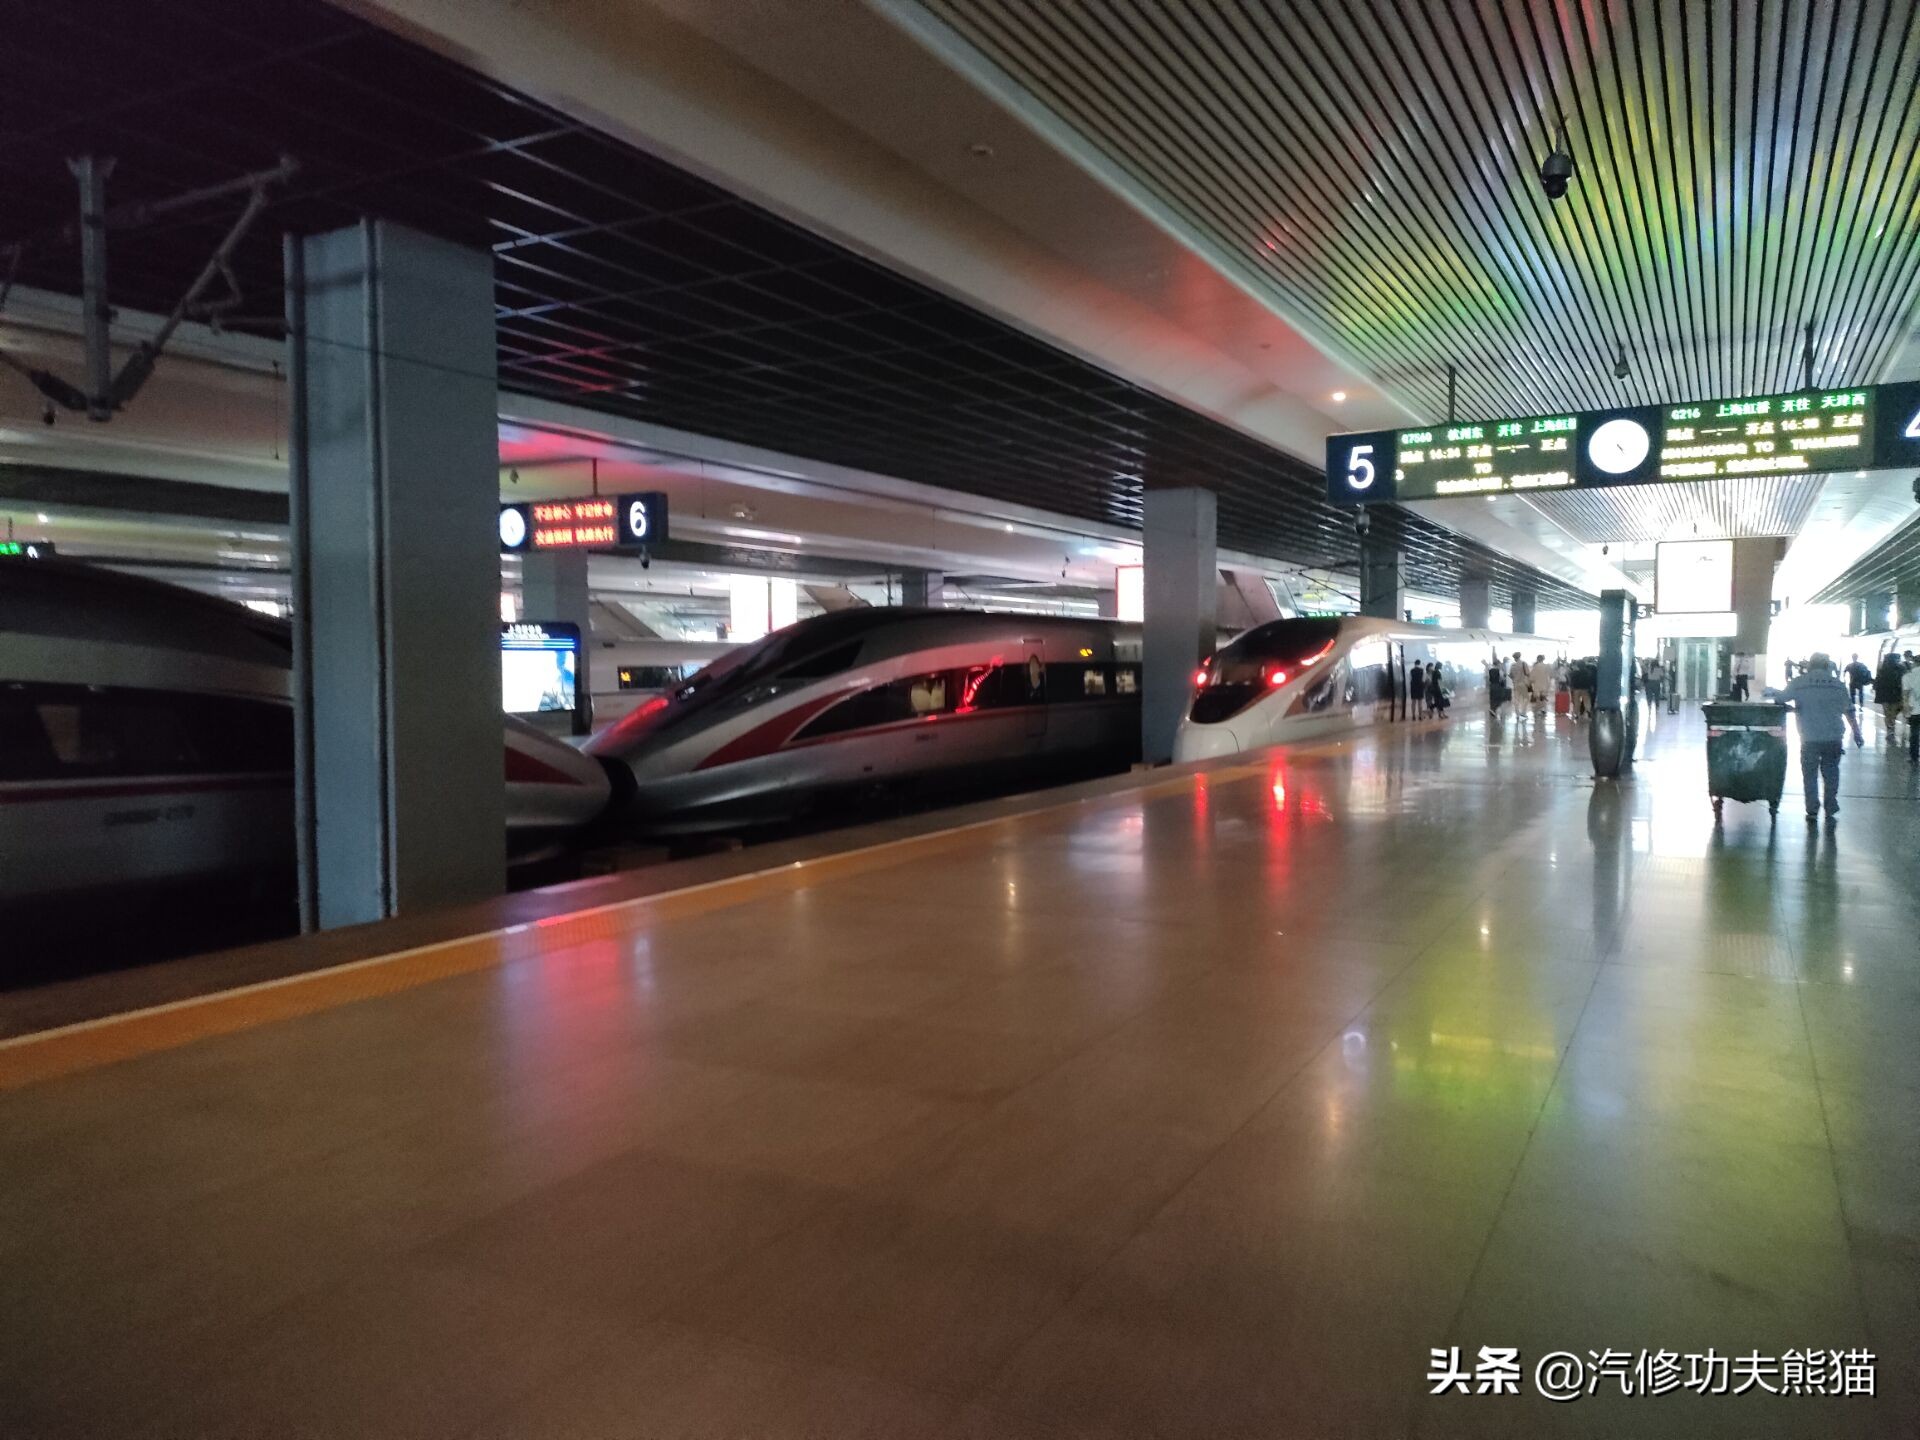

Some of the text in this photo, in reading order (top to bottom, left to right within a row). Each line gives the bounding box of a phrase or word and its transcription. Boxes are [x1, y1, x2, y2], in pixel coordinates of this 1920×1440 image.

[1671, 407, 1701, 420] G216
[1782, 397, 1811, 413] 开往
[1820, 393, 1867, 409] 天津西
[1347, 445, 1375, 489] 5
[629, 500, 647, 537] 6
